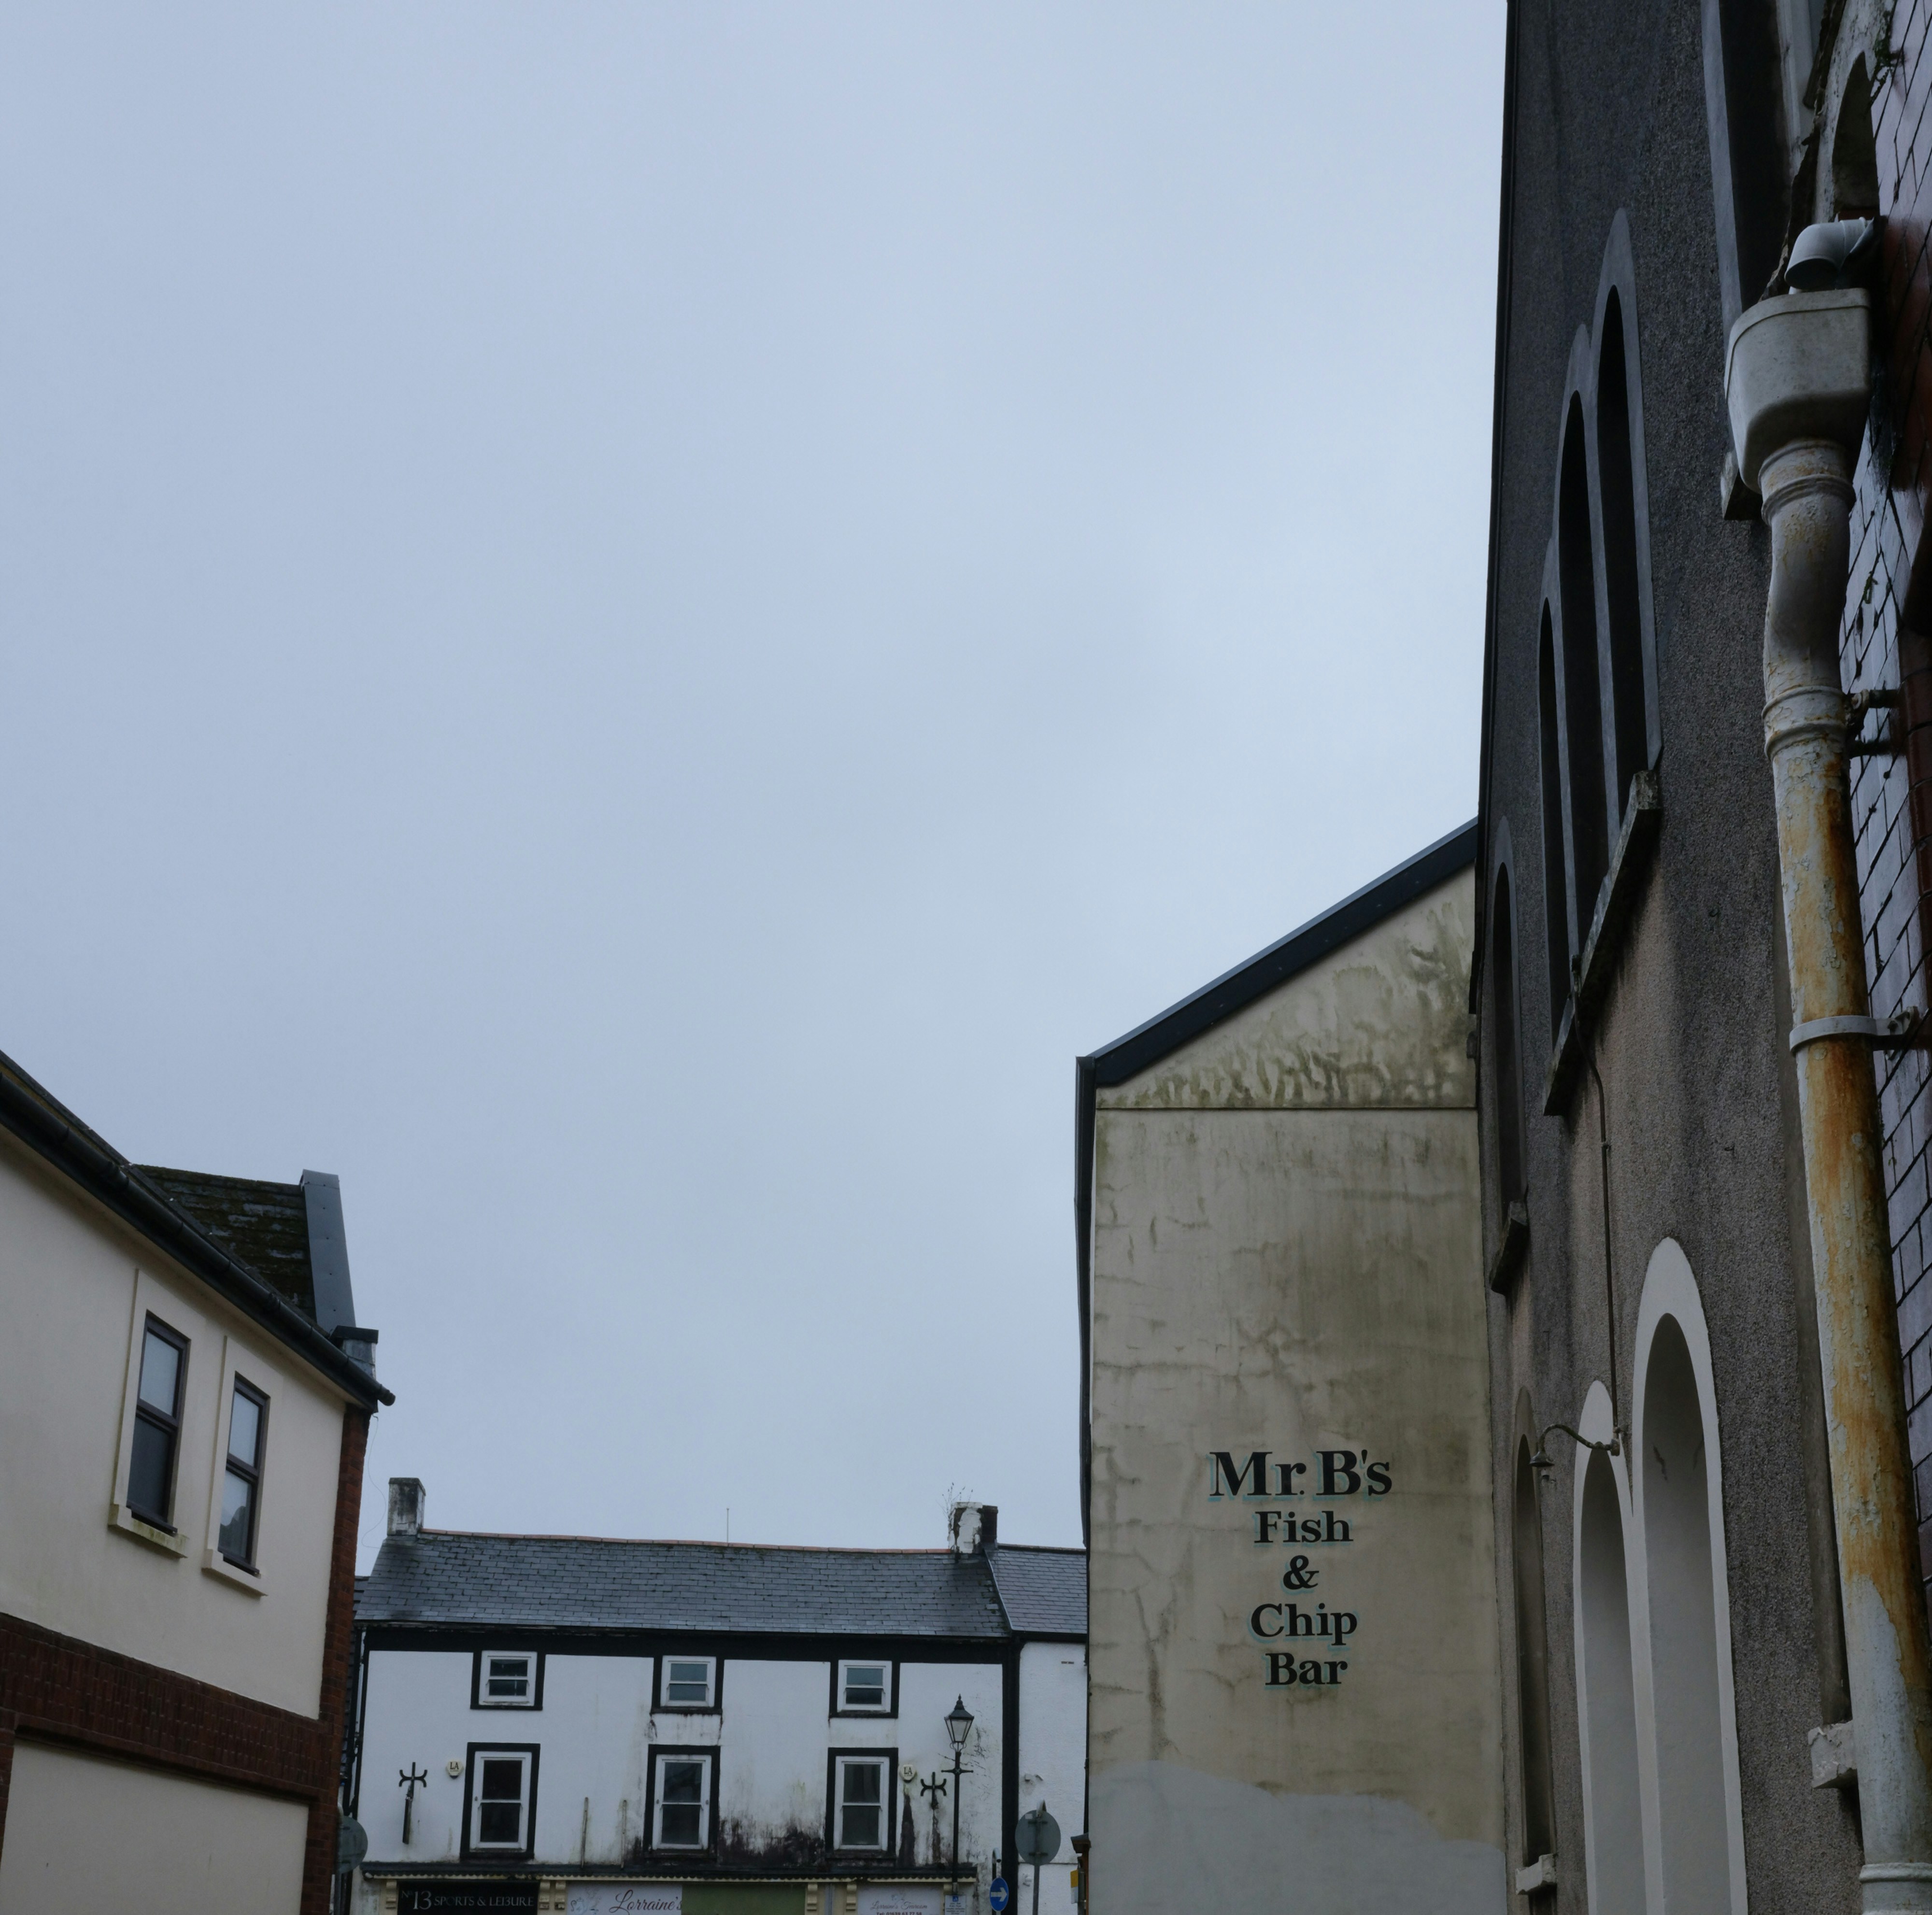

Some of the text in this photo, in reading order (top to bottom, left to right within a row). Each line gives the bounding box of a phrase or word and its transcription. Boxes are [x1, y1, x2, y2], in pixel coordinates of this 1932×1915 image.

[1209, 1449, 1392, 1496] Mr. B's
[1254, 1510, 1354, 1543] Fish
[1283, 1555, 1320, 1589] &
[1250, 1603, 1358, 1645] Chip
[1264, 1652, 1348, 1686] Bar
[412, 1890, 432, 1910] 13
[433, 1896, 475, 1906] SPORTS
[477, 1896, 486, 1906] &
